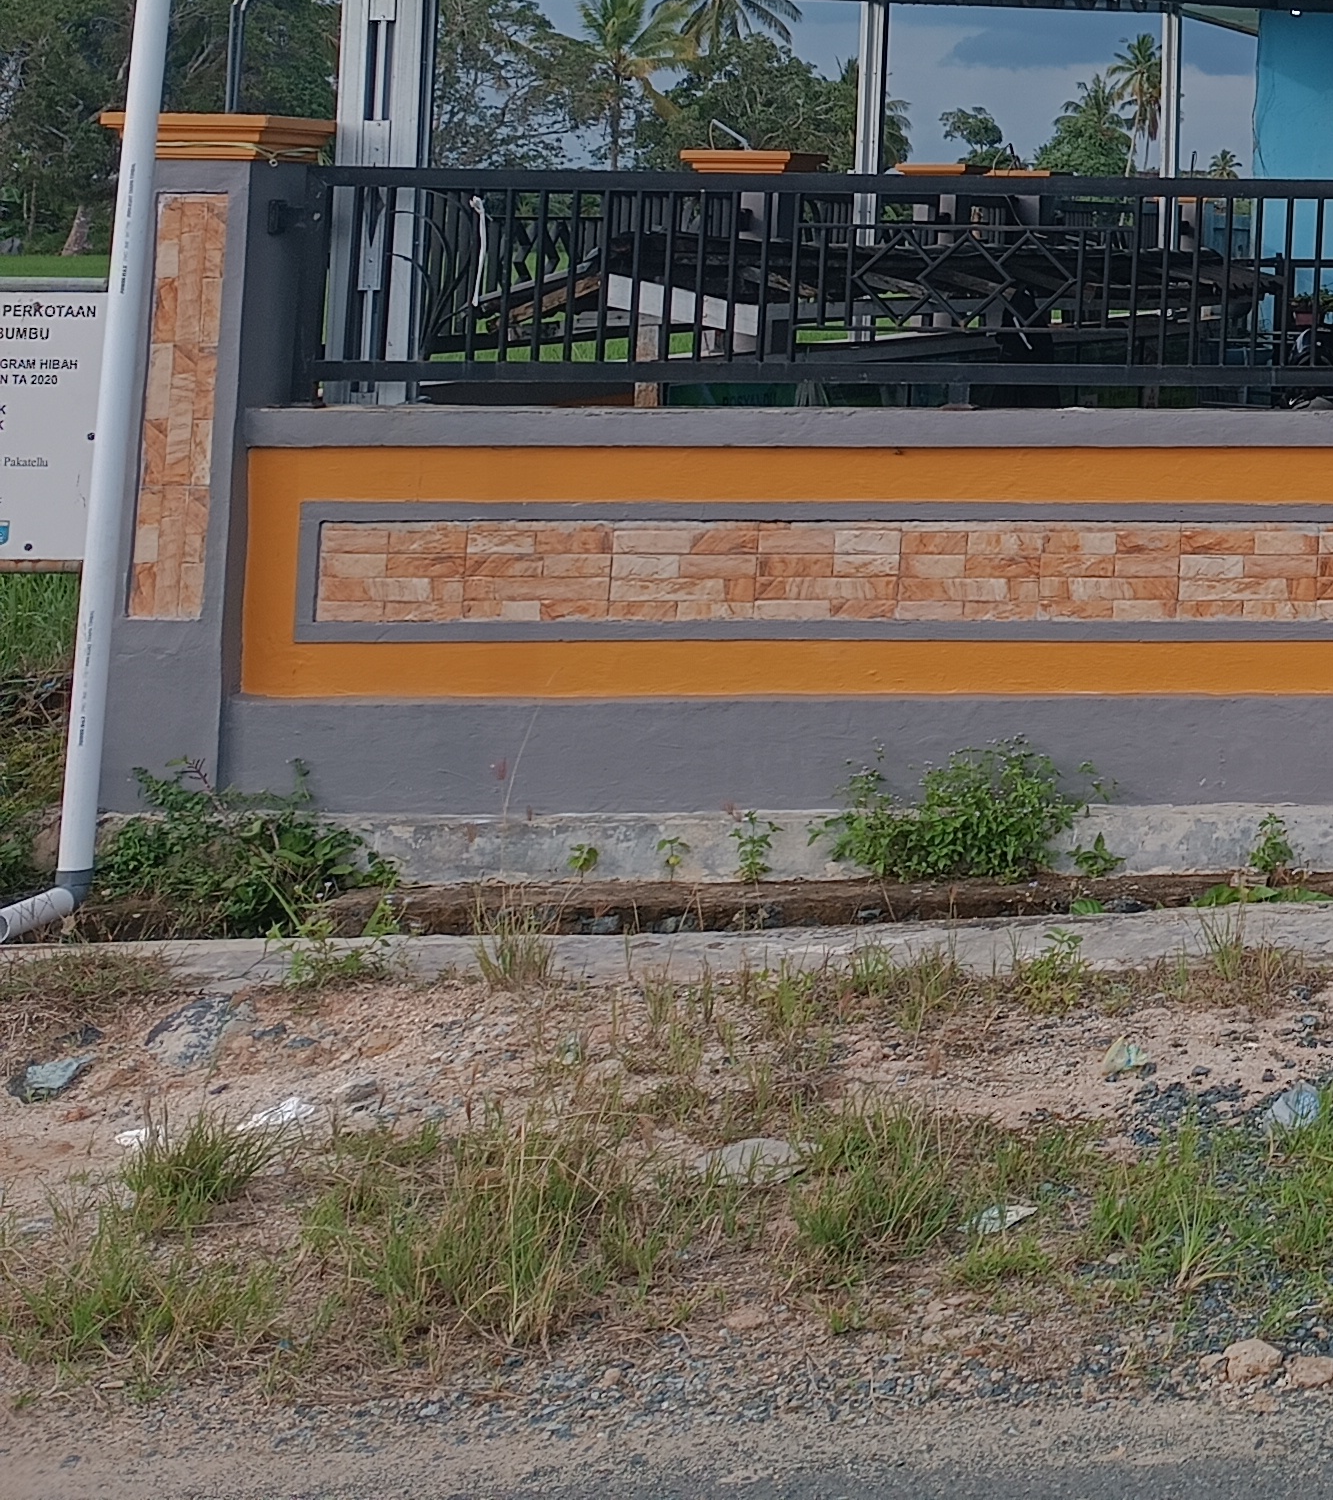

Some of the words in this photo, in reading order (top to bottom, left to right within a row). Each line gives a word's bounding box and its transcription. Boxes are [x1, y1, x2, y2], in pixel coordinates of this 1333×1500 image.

[3, 304, 97, 317] PERKOTAAN
[39, 359, 78, 370] HIBAH
[12, 375, 27, 385] TA
[30, 375, 58, 385] 2020
[3, 456, 49, 468] Pakatellu
